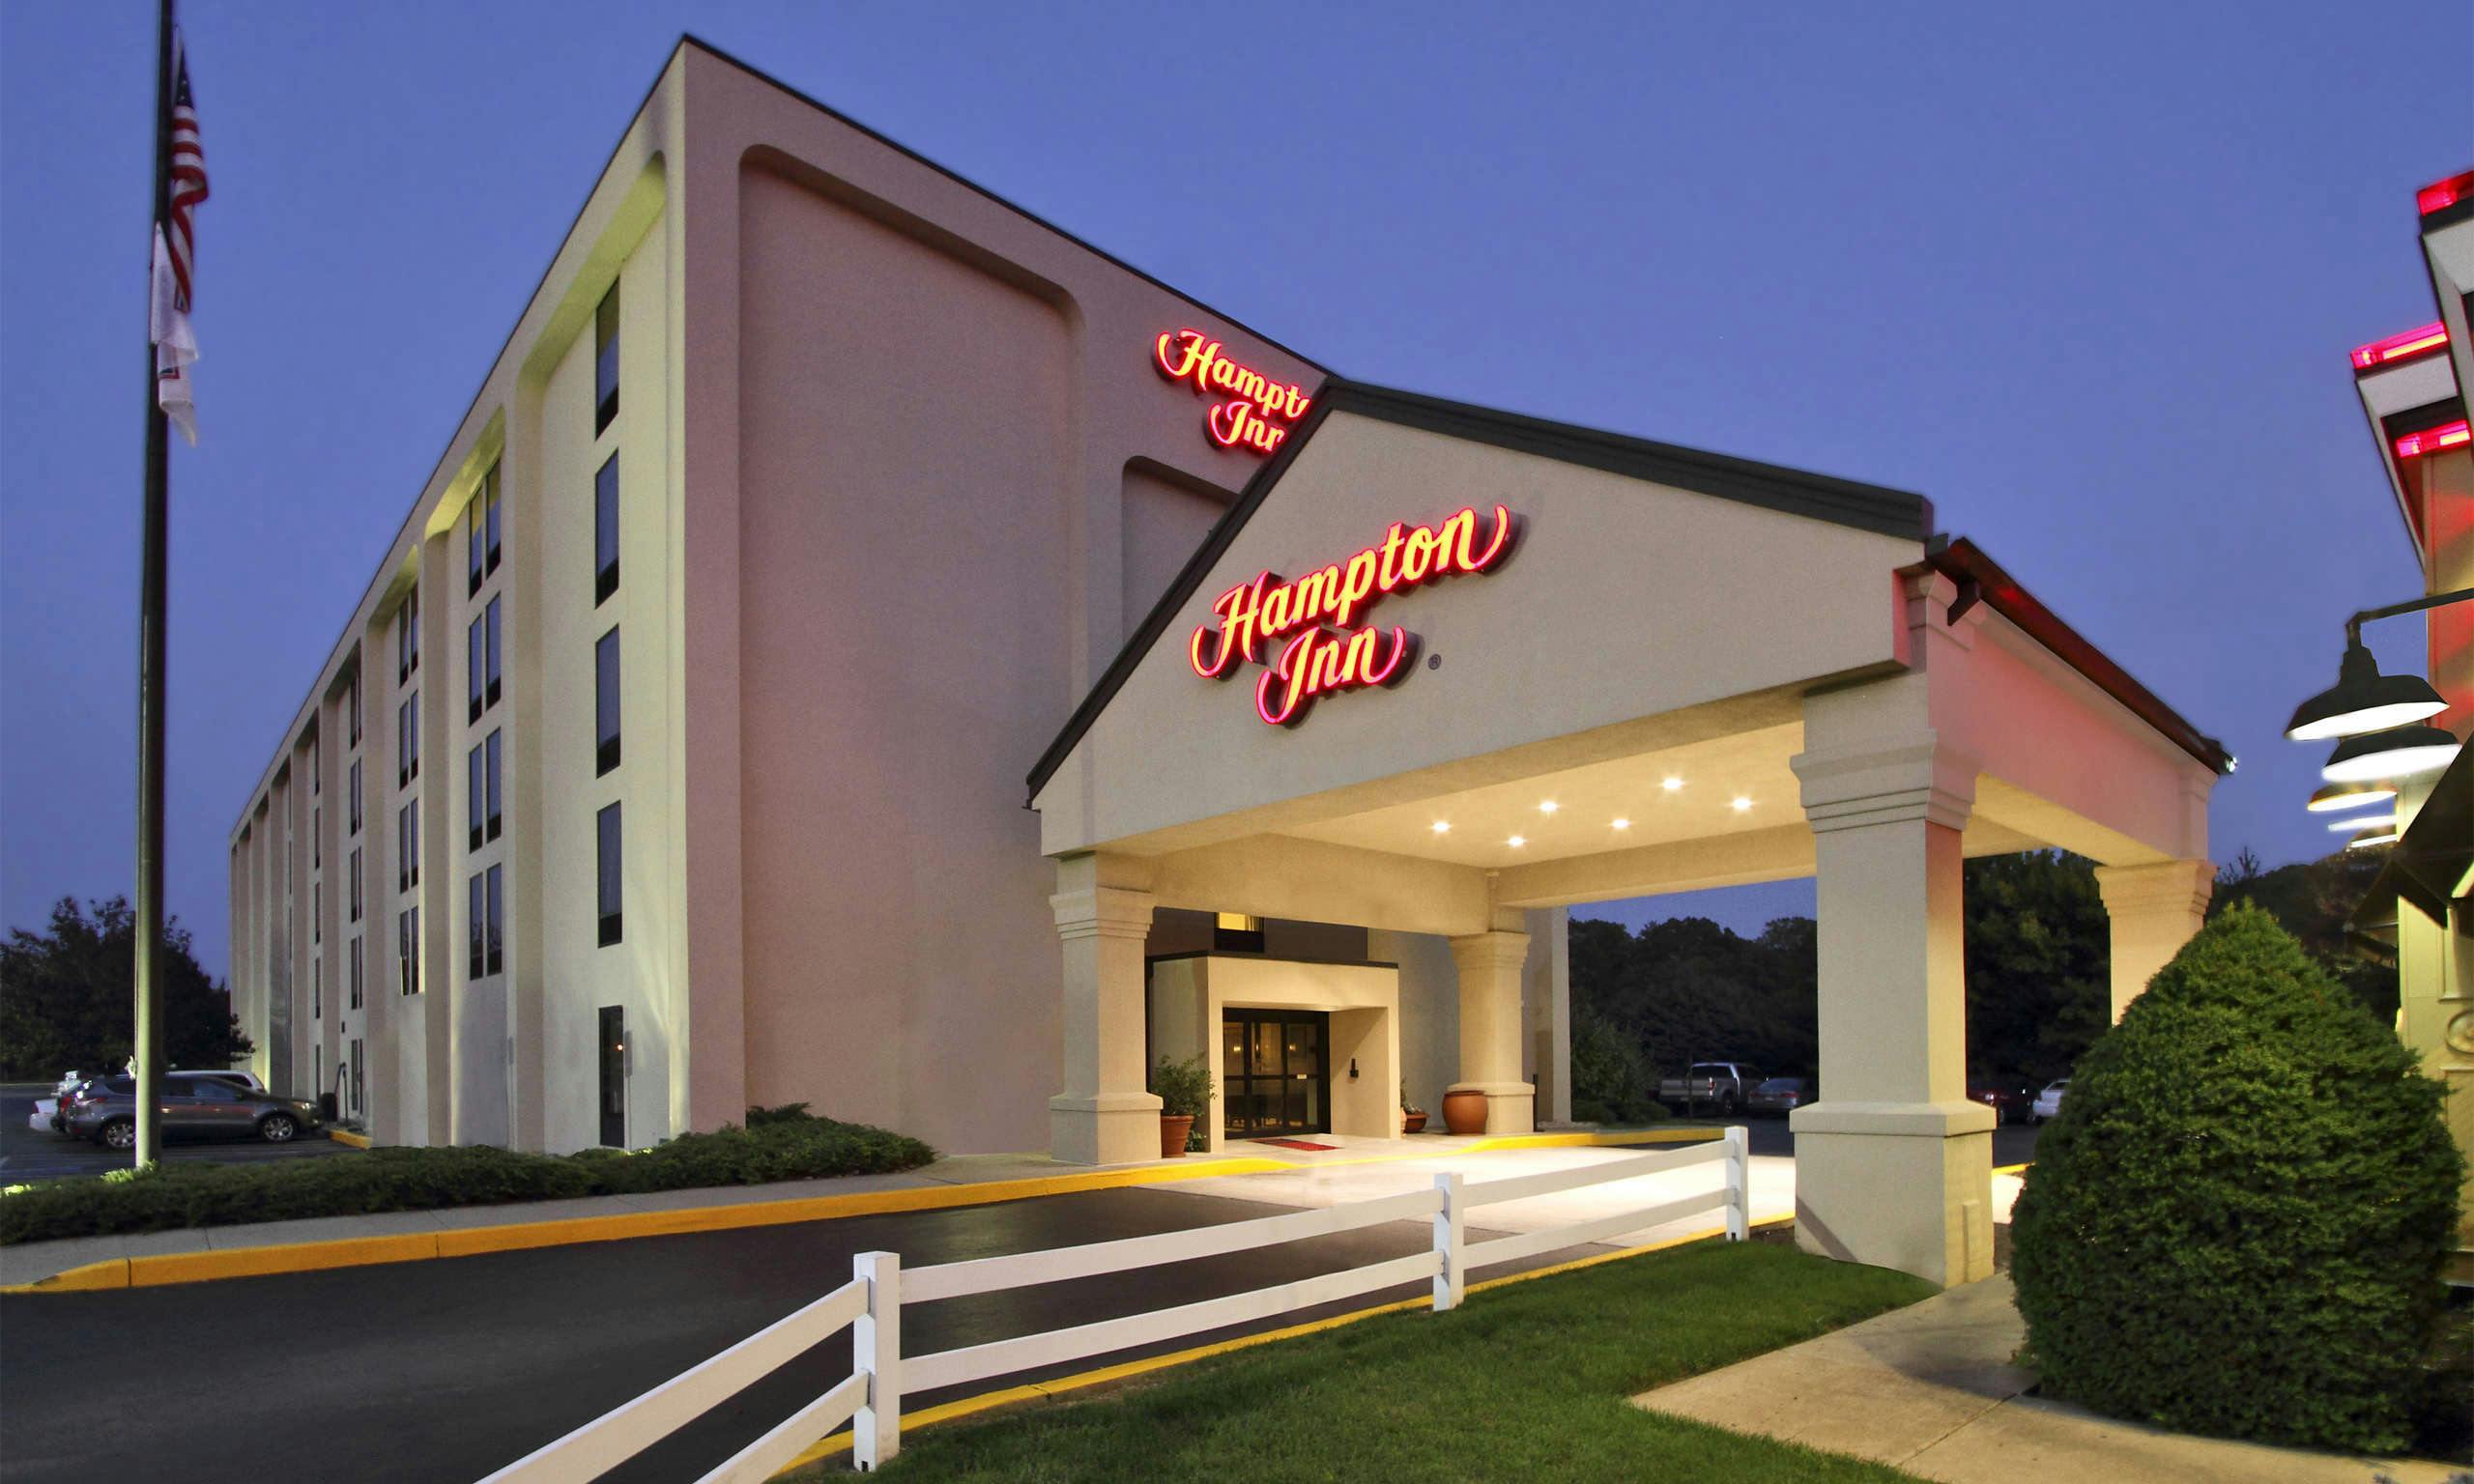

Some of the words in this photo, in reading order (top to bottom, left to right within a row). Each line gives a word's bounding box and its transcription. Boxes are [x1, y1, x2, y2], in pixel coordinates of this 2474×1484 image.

[1156, 328, 1311, 419] Hampt
[1190, 503, 1510, 677] Hampton
[1256, 625, 1407, 725] Inn
